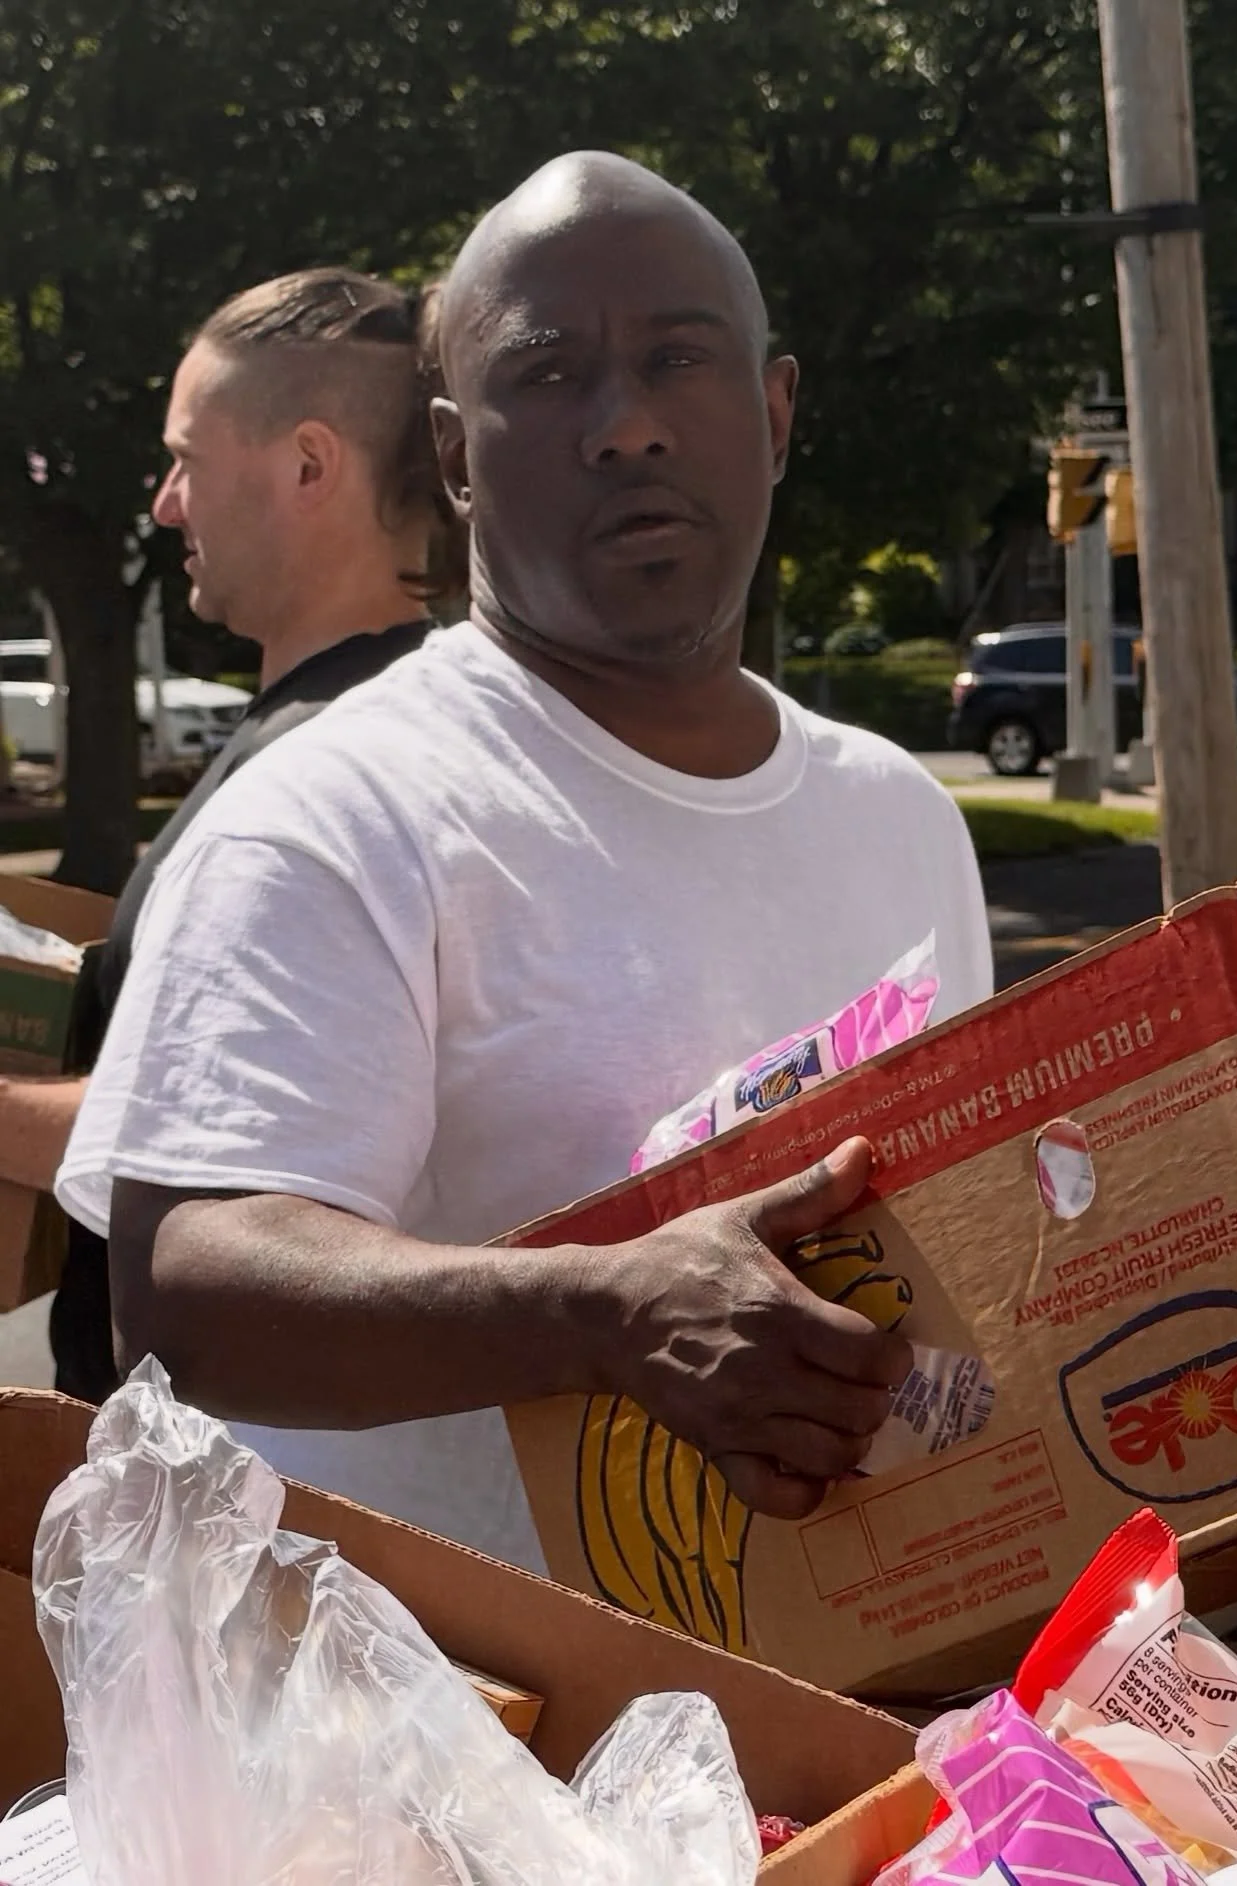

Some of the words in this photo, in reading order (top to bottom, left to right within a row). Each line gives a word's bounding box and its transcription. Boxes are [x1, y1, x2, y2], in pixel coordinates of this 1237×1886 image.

[1002, 1010, 1156, 1108] PREMIUM
[875, 1084, 1003, 1167] BANANA
[1165, 1216, 1230, 1259] FRESH
[1104, 1245, 1166, 1285] FRUIT
[1009, 1269, 1110, 1327] COMPANY
[980, 1564, 1051, 1602] PRODUCT
[1126, 1669, 1171, 1716] Serving
